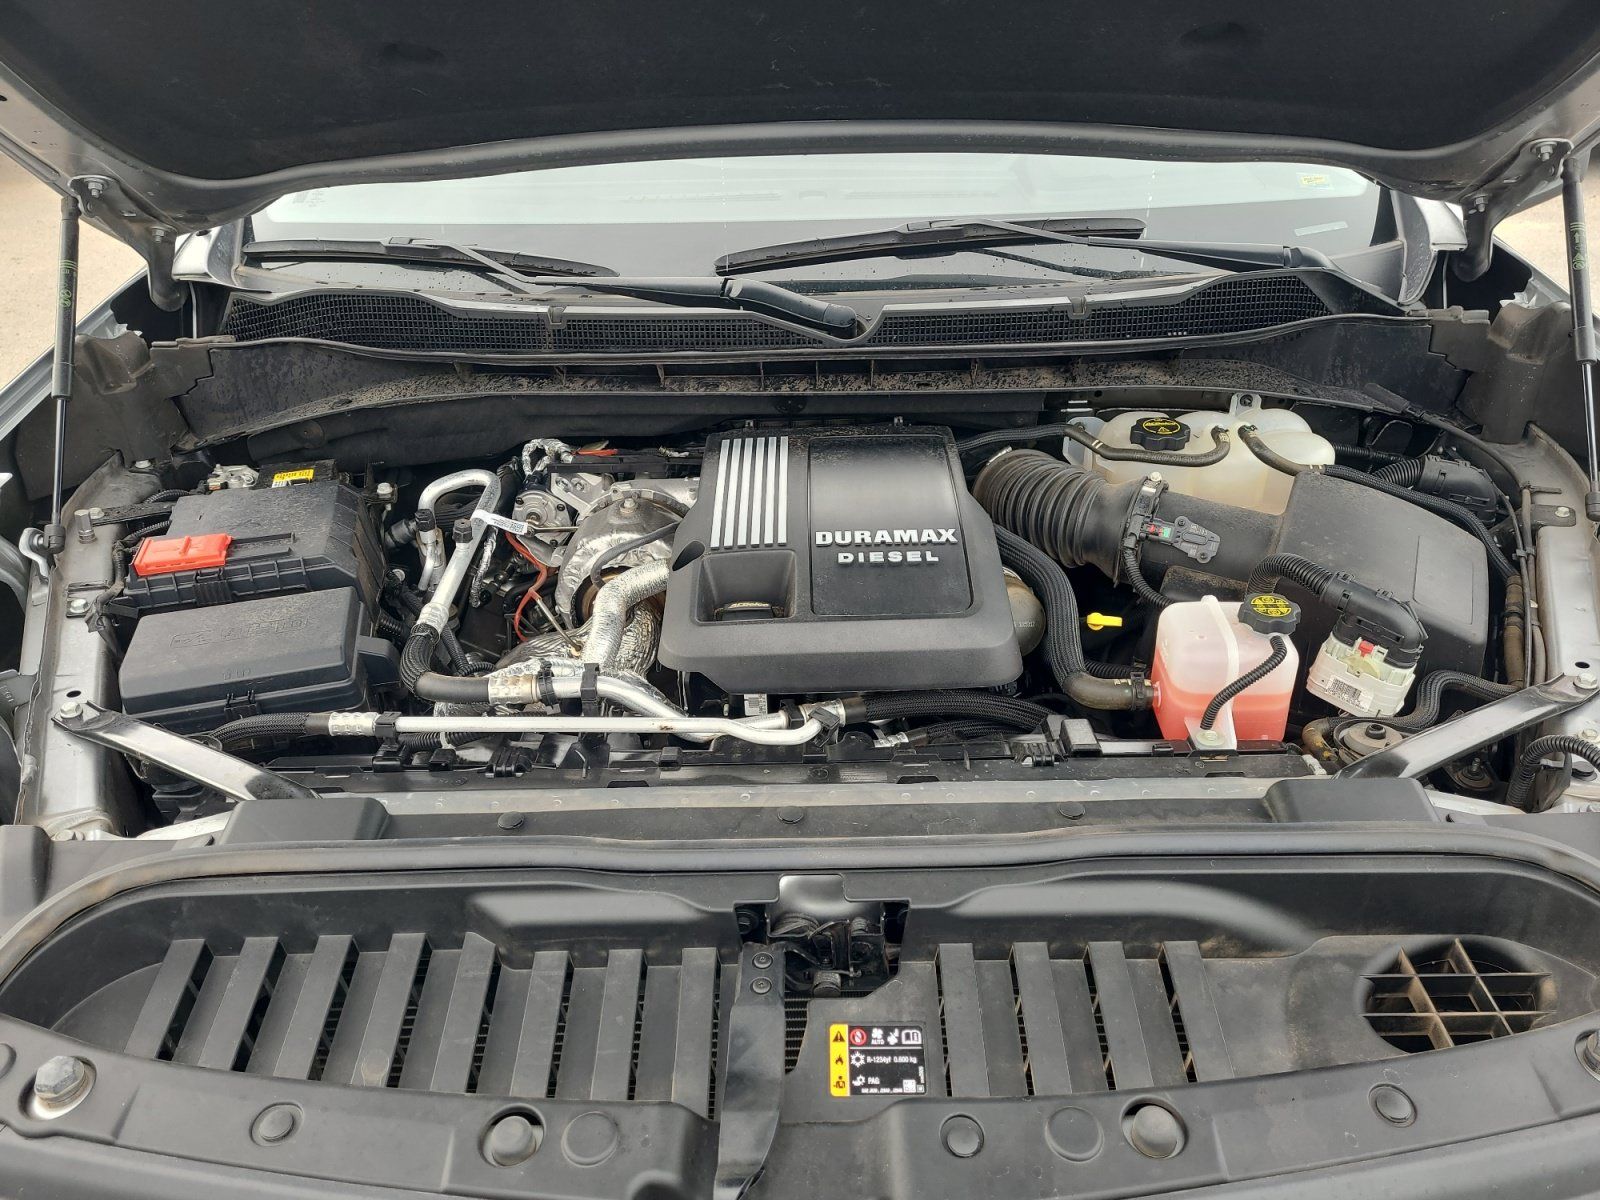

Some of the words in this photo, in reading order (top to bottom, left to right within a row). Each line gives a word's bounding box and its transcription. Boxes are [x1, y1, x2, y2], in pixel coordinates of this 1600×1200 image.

[815, 528, 958, 546] DURAMAX
[837, 550, 939, 563] DIESEL
[867, 1077, 880, 1085] PAG
